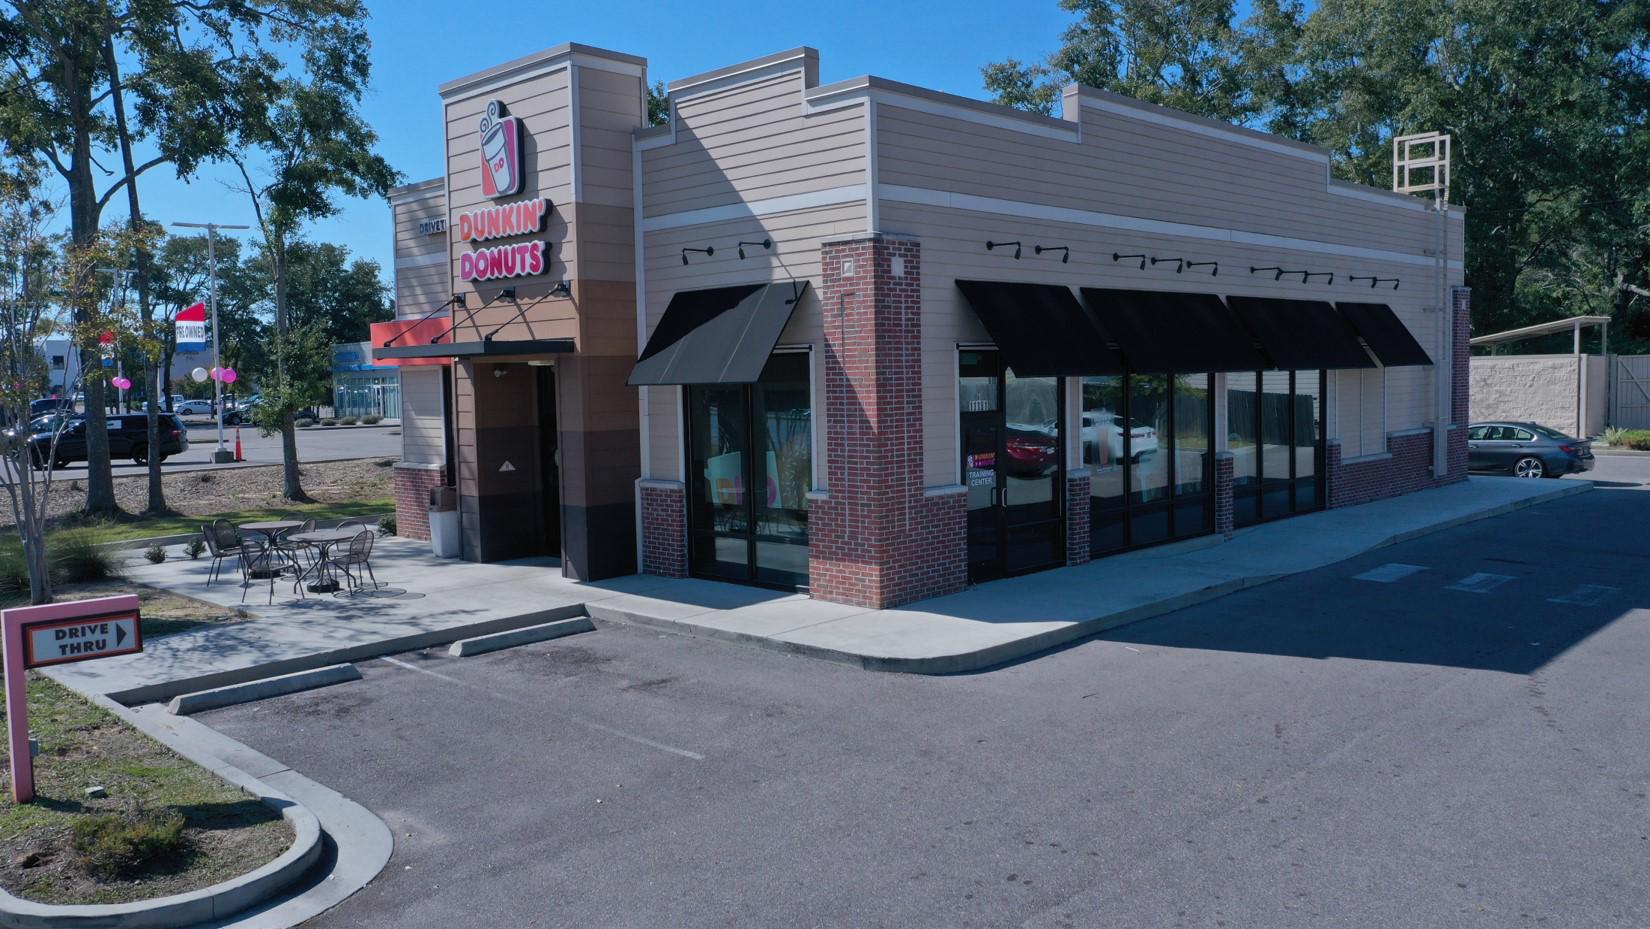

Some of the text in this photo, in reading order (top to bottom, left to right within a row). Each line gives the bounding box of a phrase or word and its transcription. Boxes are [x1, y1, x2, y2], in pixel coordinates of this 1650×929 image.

[419, 219, 447, 233] DRIVET
[459, 201, 544, 241] DUNKIN'
[460, 242, 544, 280] DONUTS
[971, 478, 993, 486] CENTER
[55, 623, 109, 641] DRIVE
[59, 639, 107, 656] THRU
